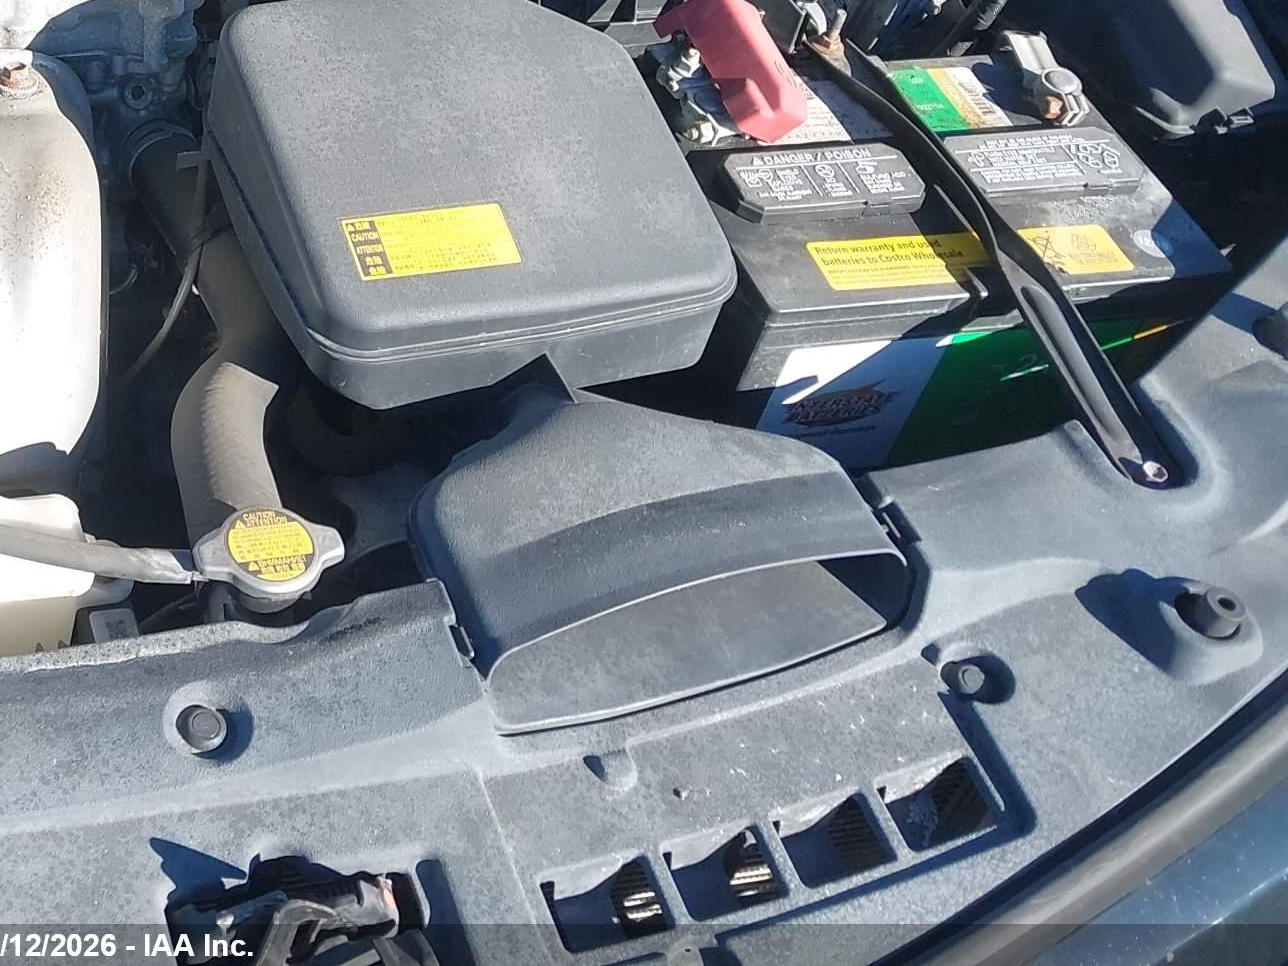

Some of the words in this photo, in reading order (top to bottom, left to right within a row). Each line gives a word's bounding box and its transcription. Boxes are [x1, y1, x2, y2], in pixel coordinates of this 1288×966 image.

[763, 153, 814, 166] DANGER
[826, 149, 872, 160] POISON
[351, 231, 380, 242] CAUTION
[356, 243, 384, 254] ATTENTION
[814, 245, 848, 255] Return
[850, 242, 895, 253] warranty
[897, 240, 915, 249] and
[917, 238, 941, 248] used
[821, 255, 866, 266] batteries
[868, 254, 878, 264] to
[880, 252, 911, 263] Costco
[912, 249, 964, 261] Wholesale
[243, 511, 276, 522] CAUTION
[246, 516, 288, 527] ATTENTION
